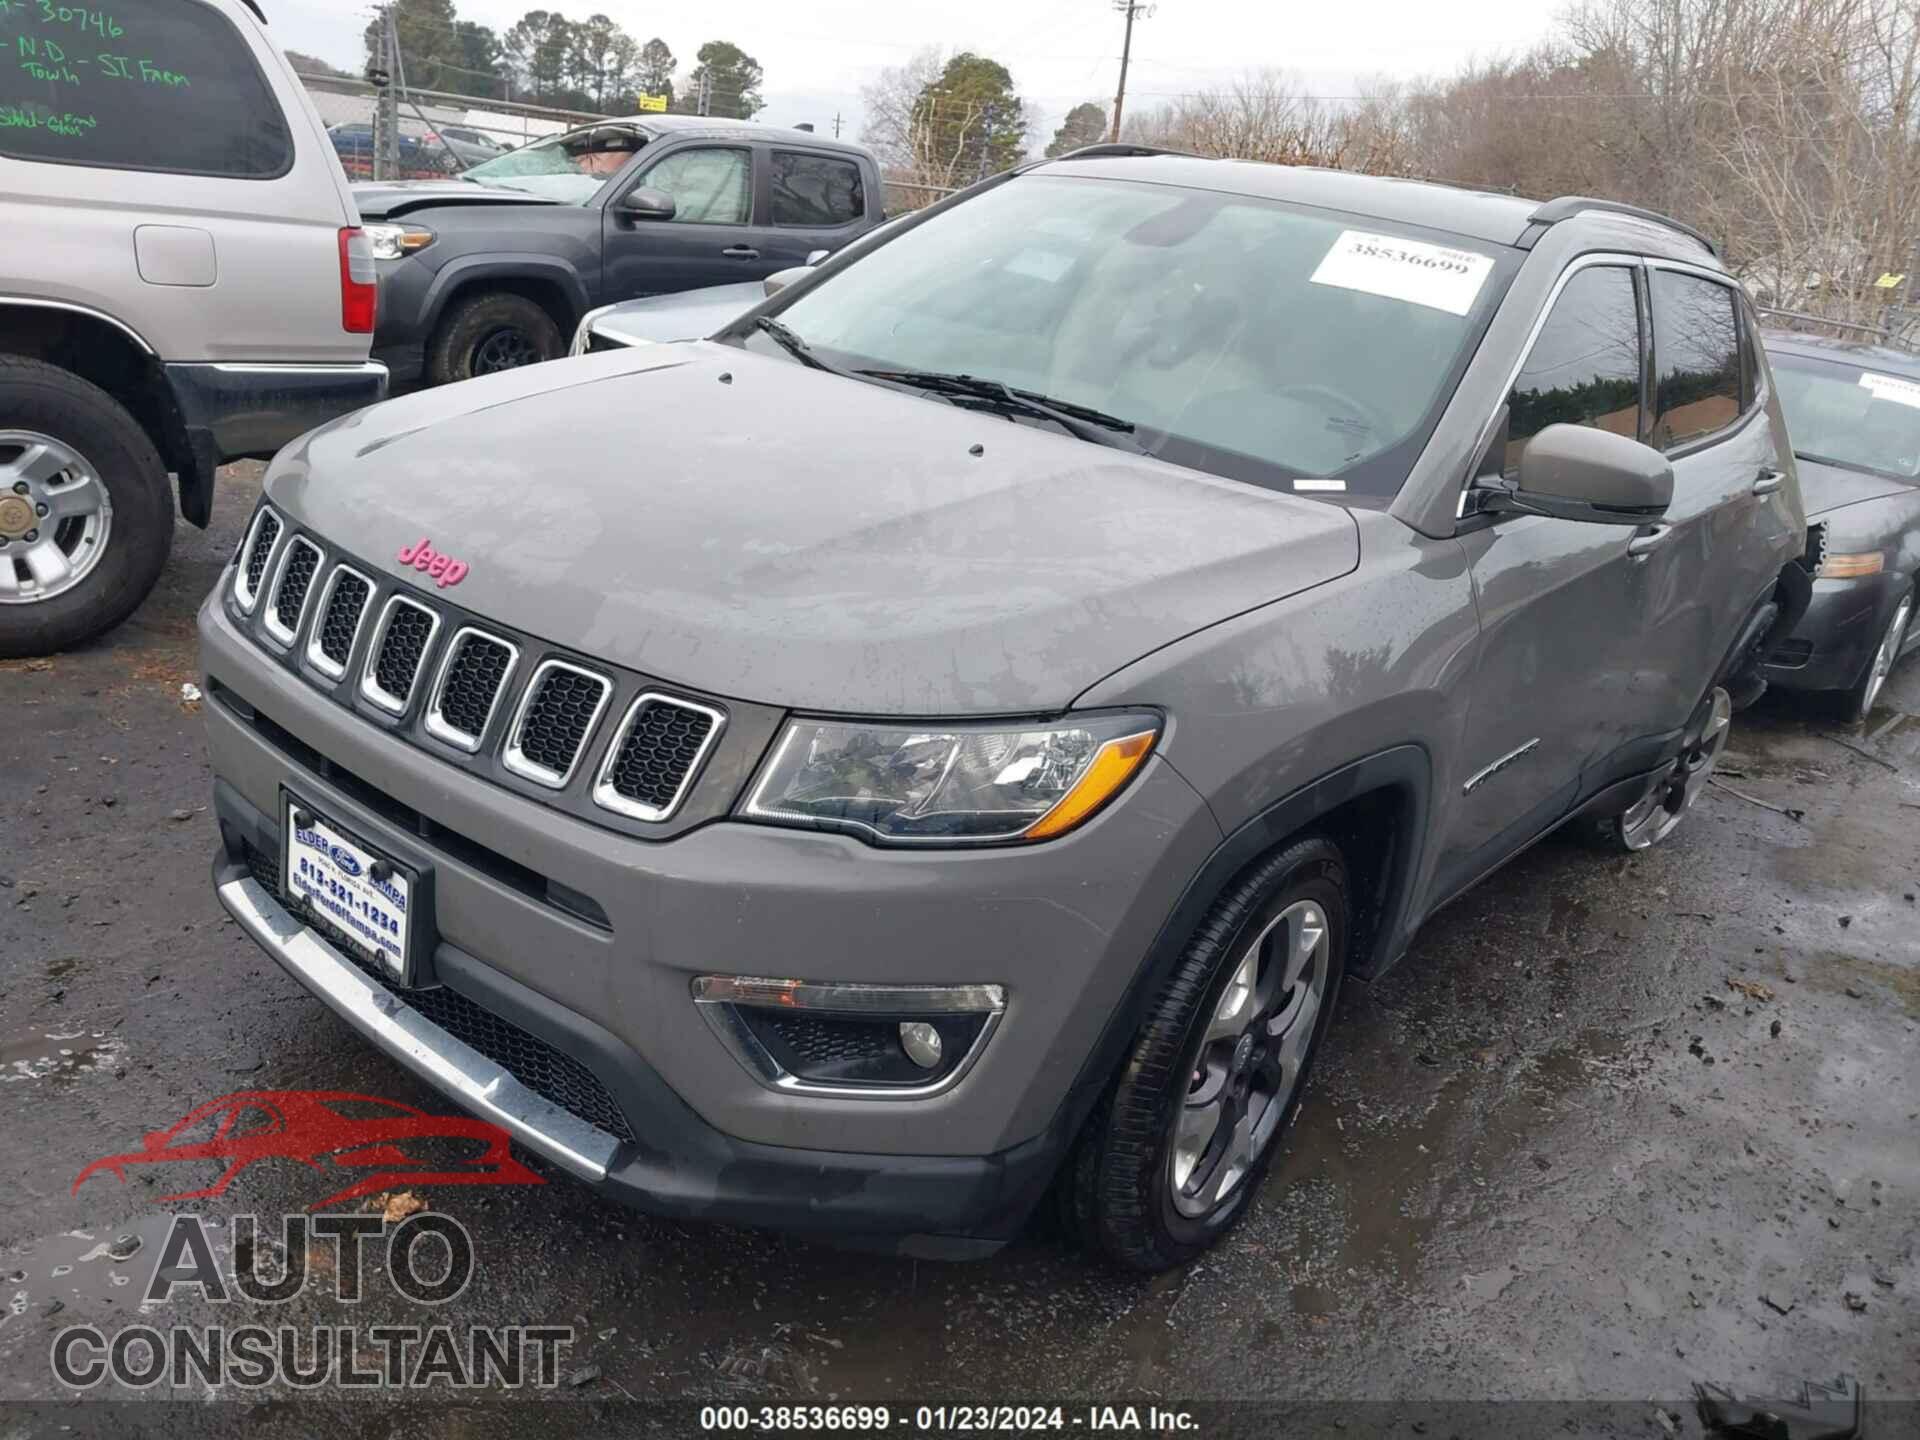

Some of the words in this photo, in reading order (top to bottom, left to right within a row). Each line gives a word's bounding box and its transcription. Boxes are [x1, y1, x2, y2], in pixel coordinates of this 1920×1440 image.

[1347, 243, 1470, 275] 38536699
[398, 537, 469, 589] Jeep
[300, 857, 399, 937] 813-321-1234
[368, 872, 406, 906] MPA
